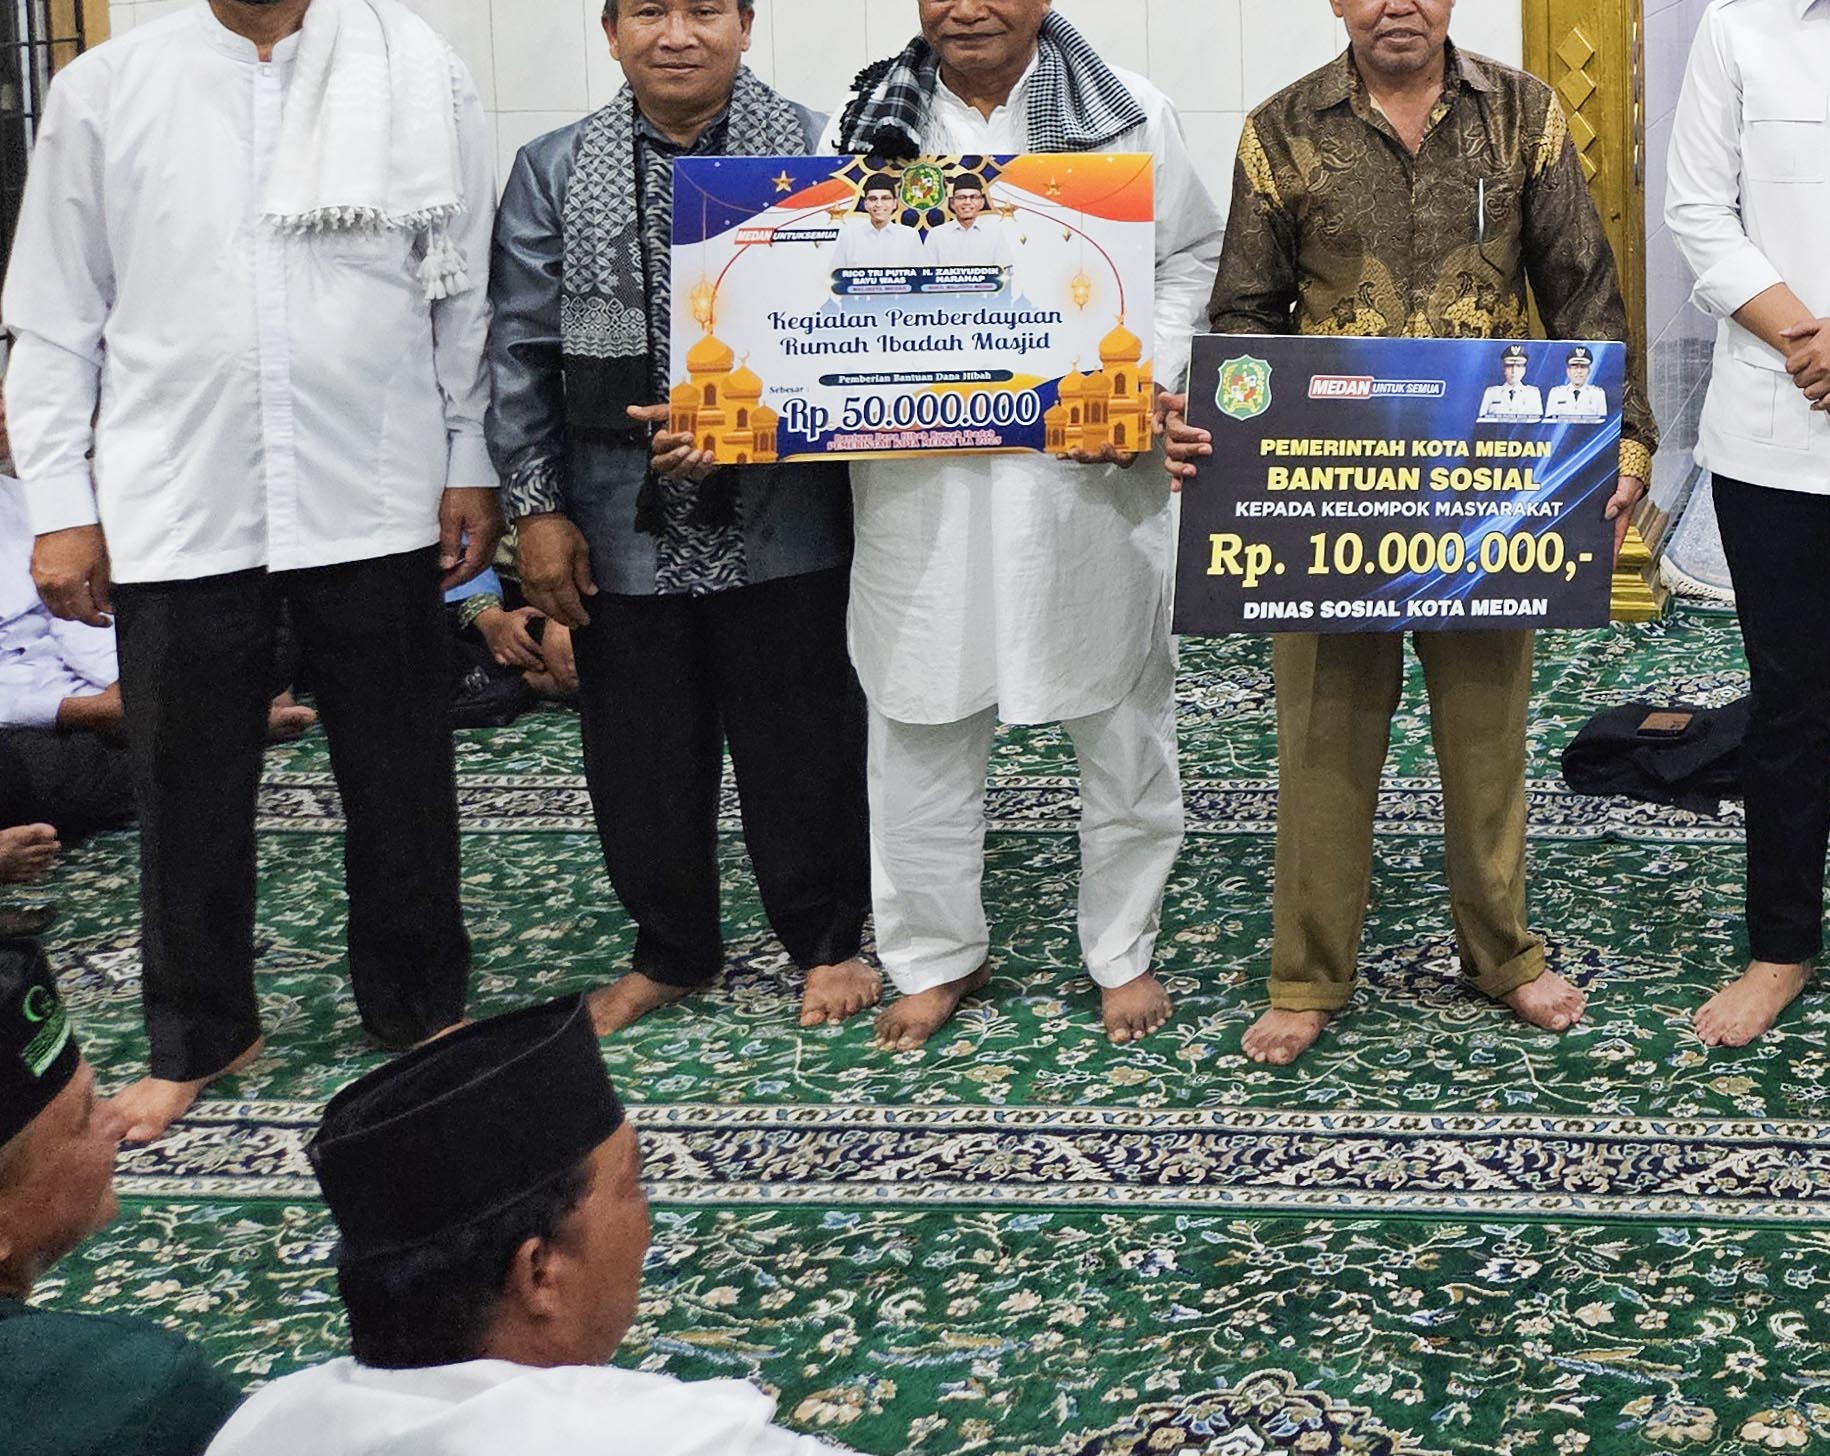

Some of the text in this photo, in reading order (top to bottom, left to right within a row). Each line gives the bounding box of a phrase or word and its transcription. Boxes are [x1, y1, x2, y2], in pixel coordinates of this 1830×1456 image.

[767, 308, 1063, 335] Kegiatan Pemberdayaan
[780, 332, 1051, 356] Rumah Ibadah Masjid
[838, 371, 991, 384] Pemberian Bantuan Dana Hibah
[1310, 378, 1440, 396] MEDAN UNTUK SEMUA
[842, 391, 1040, 428] 50.000.000
[1260, 439, 1552, 459] PEMERINTAH KOTA MEDAN
[1266, 466, 1541, 492] BANTUAN SOSIAL
[1235, 500, 1564, 518] KEPADA KELOMPOK MASYARAKAT
[1206, 531, 1594, 588] Rp. 10.000.000,-
[1243, 598, 1549, 620] DINAS SOSIAL KOTA MEDAN
